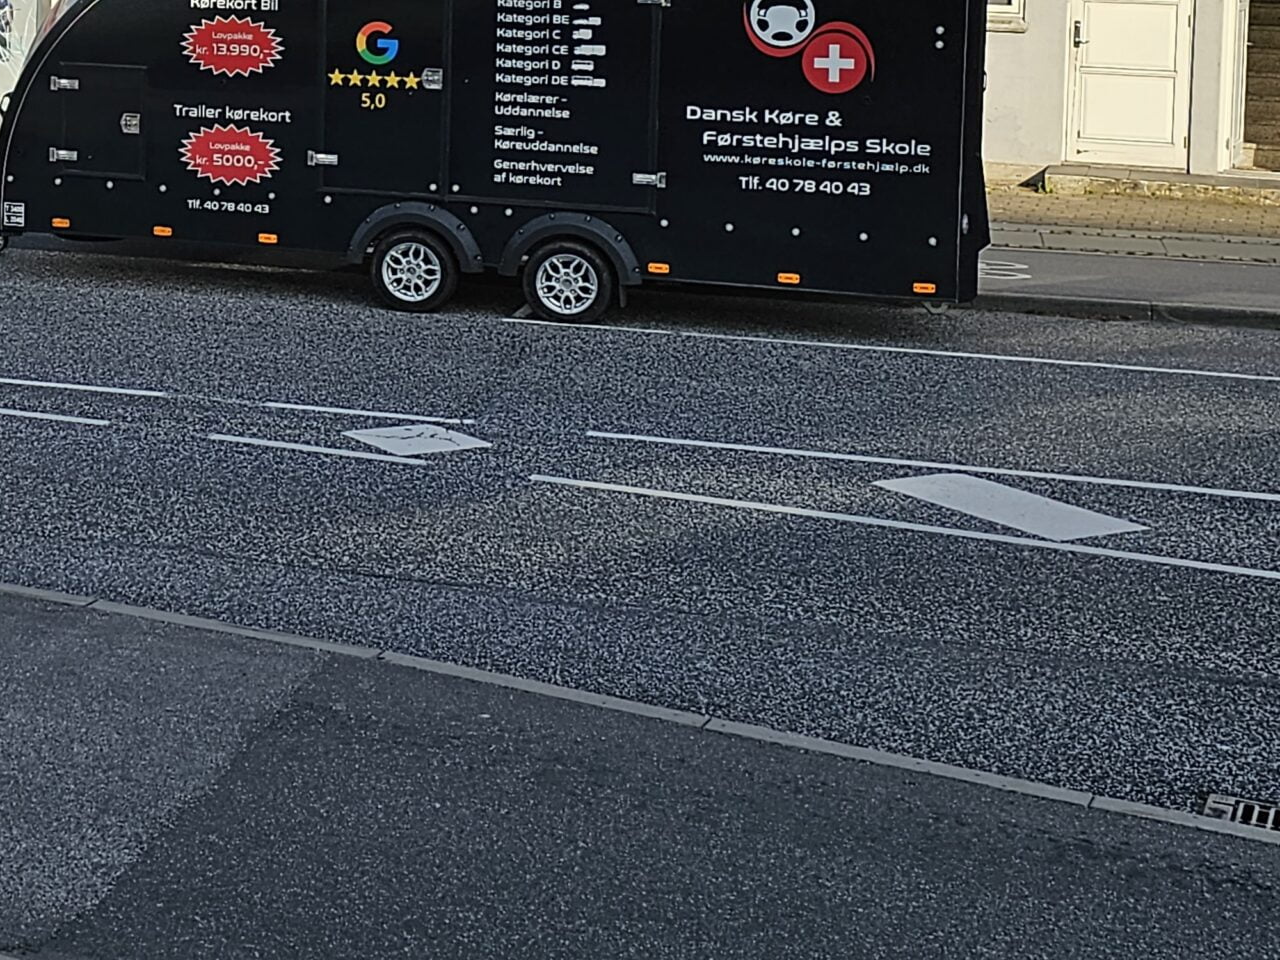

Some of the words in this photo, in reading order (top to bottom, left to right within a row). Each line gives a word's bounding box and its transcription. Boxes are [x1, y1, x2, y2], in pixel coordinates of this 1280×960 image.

[553, 0, 562, 9] B
[497, 13, 550, 26] Kategori
[552, 15, 570, 24] BE
[211, 31, 253, 41] Lovpakke
[496, 28, 549, 40] Kategori
[552, 30, 561, 39] C
[356, 21, 398, 65] G
[496, 43, 549, 55] Kategori
[552, 45, 569, 55] CE
[196, 44, 209, 55] kr.
[212, 43, 270, 59] 13.990,-
[496, 58, 549, 71] Kategori
[551, 60, 561, 70] D
[495, 73, 548, 86] Kategori
[551, 76, 569, 85] DE
[361, 92, 386, 110] 5,0
[495, 92, 559, 104] Kørelærer
[173, 104, 222, 118] Trailer
[226, 106, 291, 122] kørekort
[495, 105, 570, 118] Uddannelse
[686, 105, 758, 124] Dansk
[764, 109, 819, 125] Køre
[825, 111, 843, 127] &
[494, 126, 535, 139] Særlig
[209, 142, 250, 151] Lovpakke
[494, 139, 599, 154] Køreuddannelse
[703, 131, 859, 155] Førstehjælps
[865, 139, 931, 156] Skole
[196, 155, 209, 165] kr.
[213, 154, 264, 170] 5000,-
[493, 159, 594, 174] Generhvervelse
[703, 153, 930, 174] www.køreskole-førstehjælp.dk
[493, 172, 507, 182] af
[509, 172, 562, 186] kørekort
[739, 176, 763, 190] Tlf.
[765, 178, 790, 192] 40
[792, 179, 817, 193] 78
[819, 181, 844, 194] 40
[846, 183, 871, 196] 43
[187, 199, 202, 209] Tlf.
[203, 201, 219, 210] 40
[220, 202, 236, 211] 78
[237, 203, 252, 212] 40
[254, 204, 270, 213] 43
